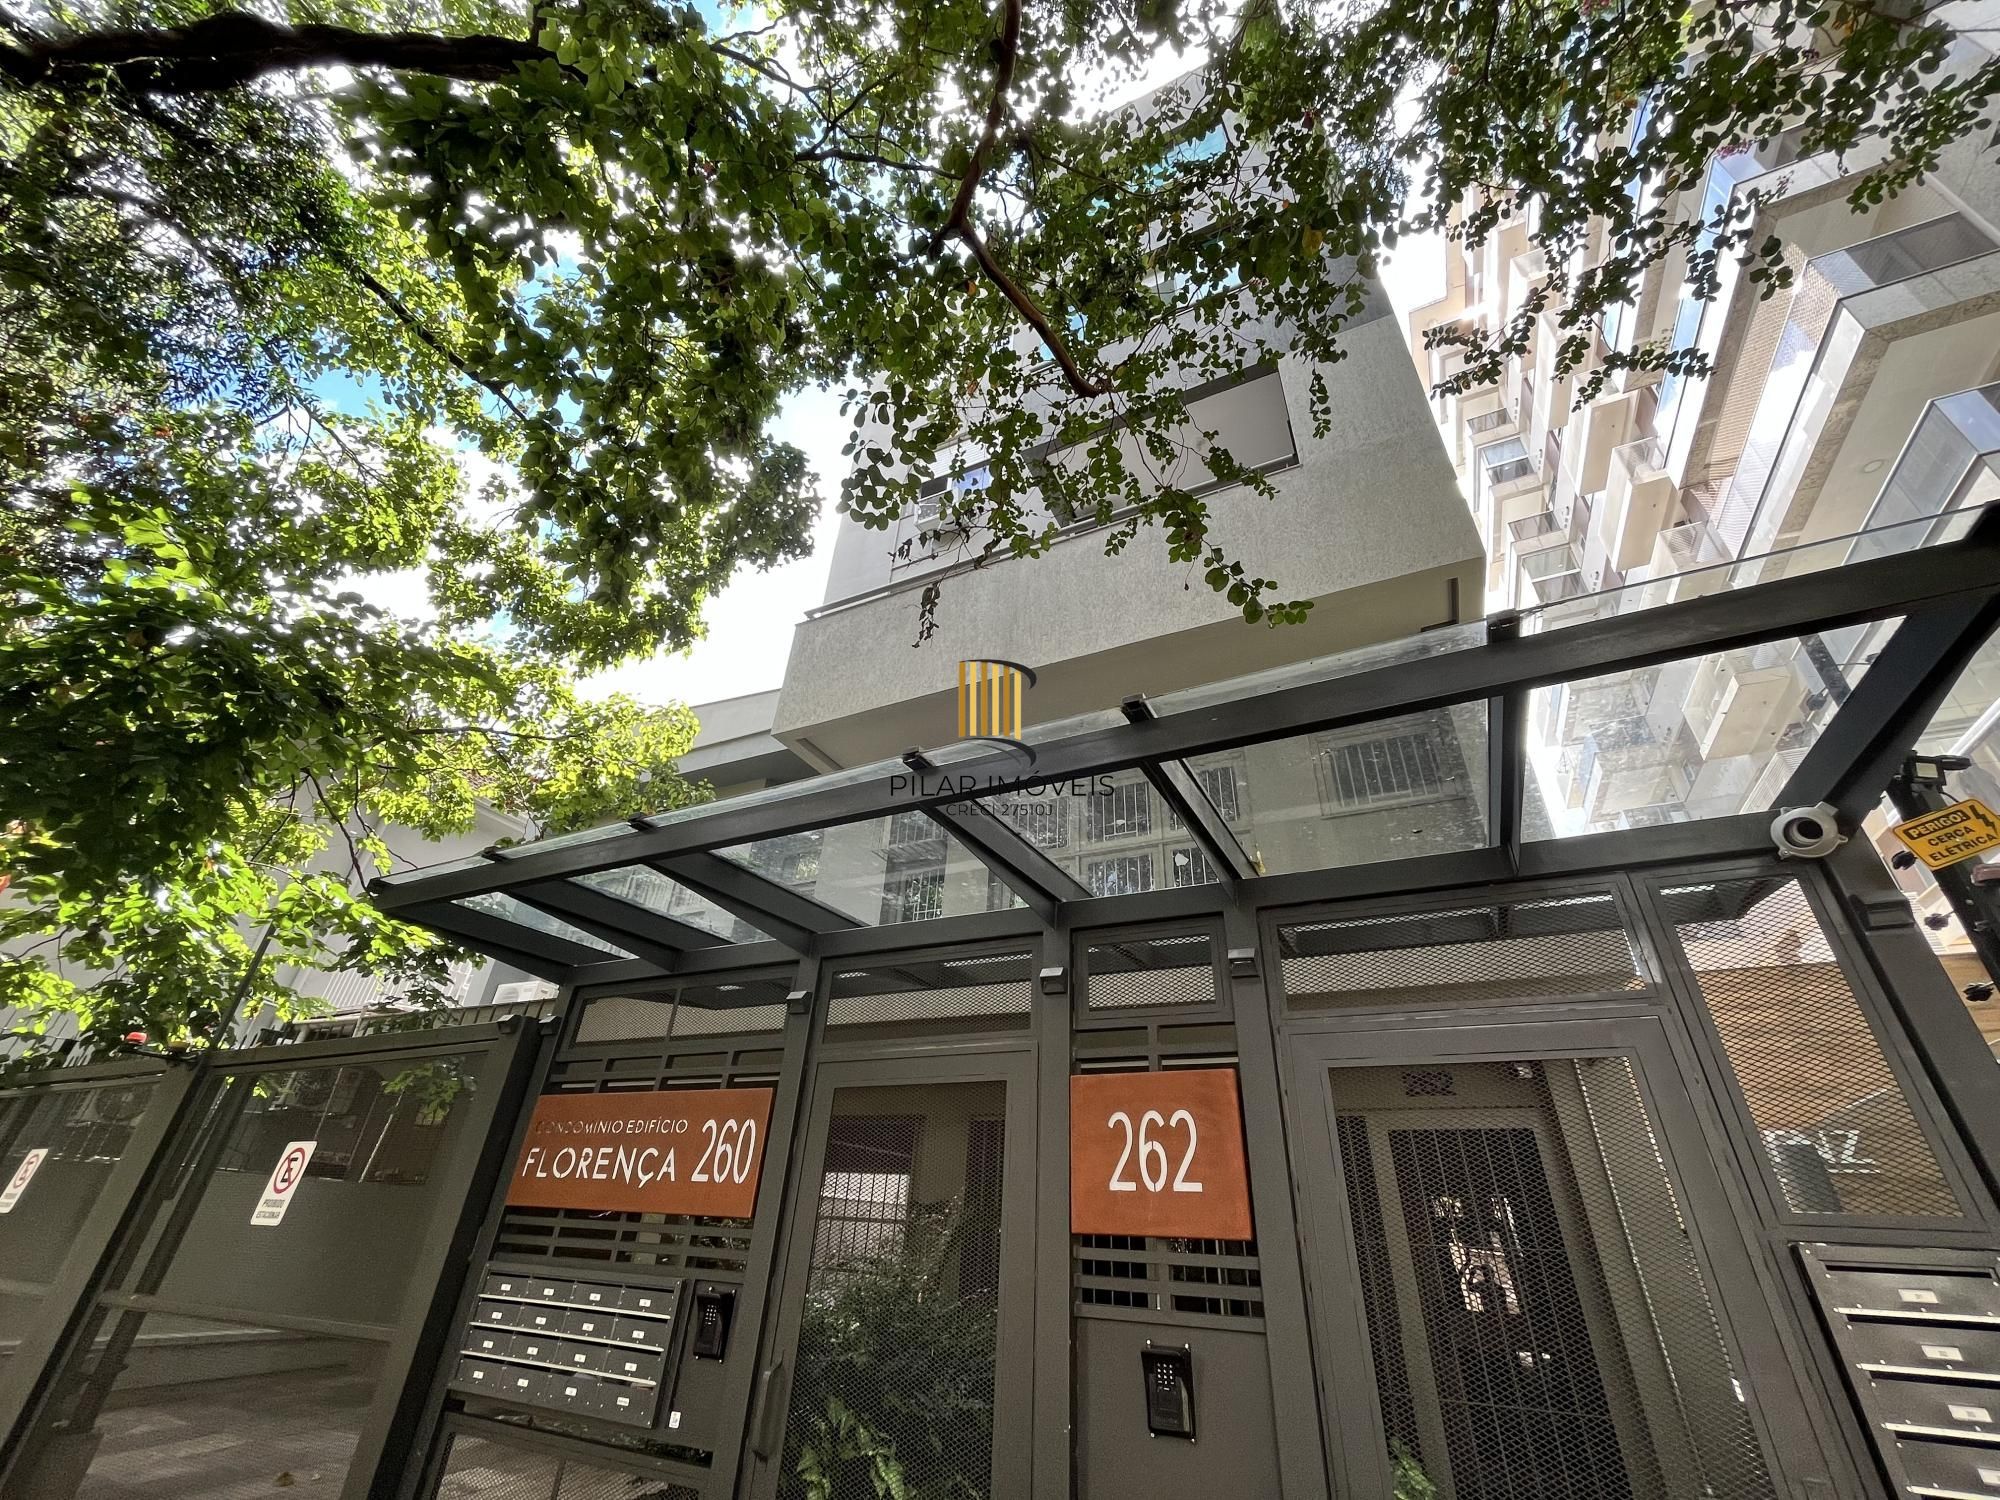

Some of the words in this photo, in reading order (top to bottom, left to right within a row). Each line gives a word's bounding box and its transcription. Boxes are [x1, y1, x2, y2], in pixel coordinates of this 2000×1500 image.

[1907, 811, 1967, 838] PERIGO!
[1928, 826, 1975, 846] CERCA
[626, 1116, 688, 1134] EDIFÍCIO
[522, 1144, 676, 1188] FLORENÇA
[691, 1119, 756, 1184] 260
[1108, 1110, 1203, 1192] 262
